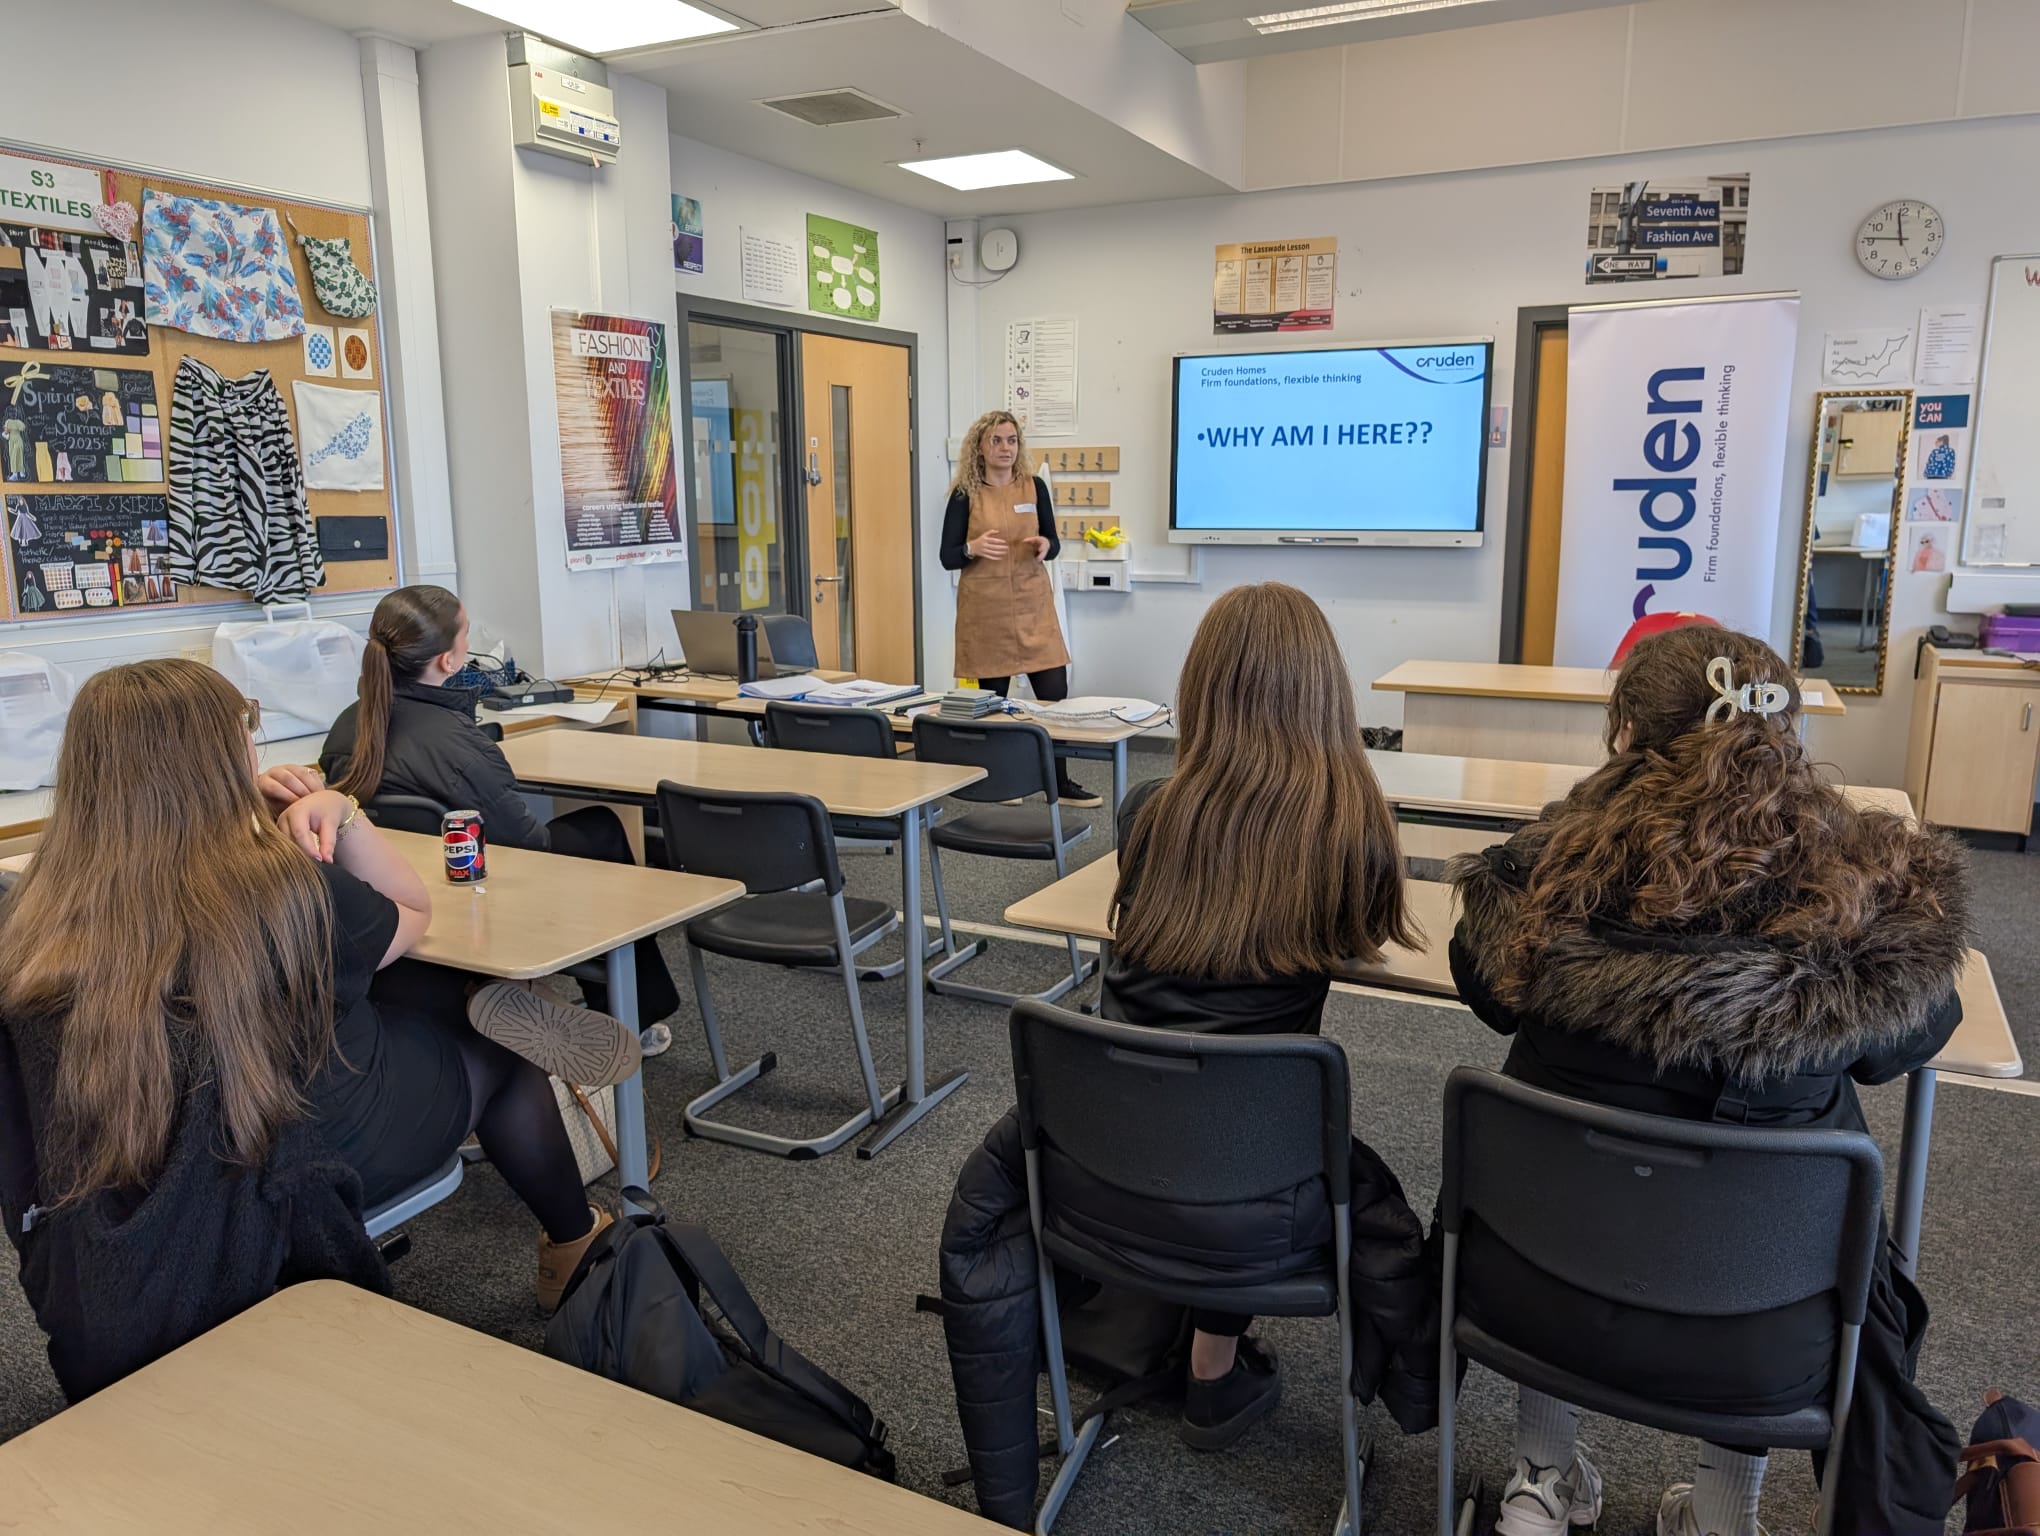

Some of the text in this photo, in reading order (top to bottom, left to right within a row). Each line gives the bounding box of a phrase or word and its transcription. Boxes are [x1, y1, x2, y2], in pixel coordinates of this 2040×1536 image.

[30, 169, 55, 189] S3
[0, 189, 92, 219] TEXTILES
[1646, 205, 1716, 217] Seventh Ave
[1872, 222, 1883, 232] 10
[1924, 219, 1933, 228] 2
[1646, 230, 1714, 243] Fashion Ave
[1928, 232, 1935, 242] 3
[1287, 243, 1310, 251] Lesson
[1921, 246, 1929, 256] 4
[1870, 250, 1878, 259] 8
[1603, 258, 1646, 269] ONE WAY
[1880, 259, 1888, 269] 7
[1894, 261, 1902, 271] 6
[1910, 258, 1917, 266] 5
[578, 333, 643, 357] FASHION
[1416, 352, 1475, 368] cruden
[608, 361, 627, 375] AND
[1201, 366, 1267, 377] Cruden Homes
[1201, 372, 1362, 388] Firm foundations, flexible thinking
[583, 377, 645, 401] TEXTILES
[22, 381, 76, 414] Spring
[56, 412, 116, 436] Summer
[1919, 413, 1942, 423] CAN
[1206, 420, 1433, 448] WHY AM I HERE??
[67, 437, 101, 450] 2025
[1704, 364, 1736, 582] Firm foundations, flexible thinking
[1613, 367, 1705, 622] ruden
[34, 495, 166, 513] MAXI SKIRTS
[606, 502, 622, 511] using
[444, 845, 476, 854] PEPSI
[450, 868, 470, 876] MAX
